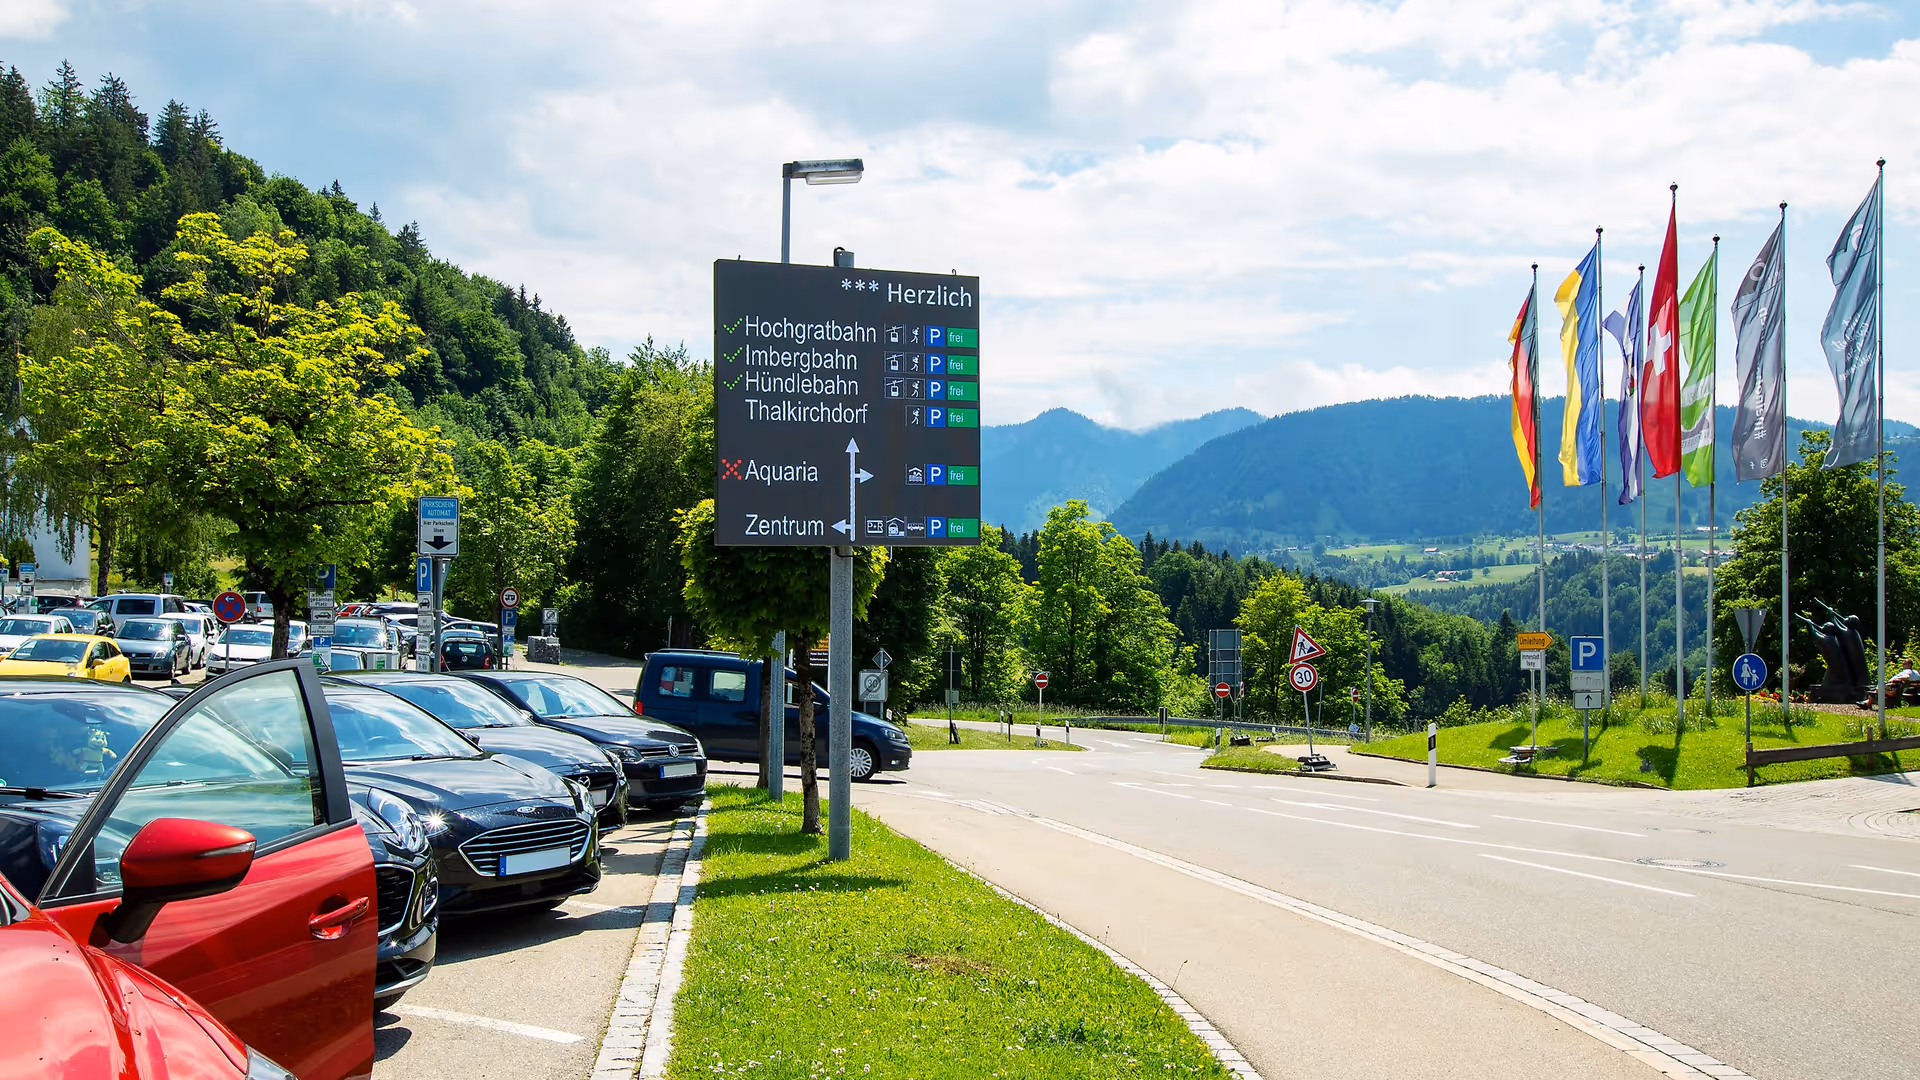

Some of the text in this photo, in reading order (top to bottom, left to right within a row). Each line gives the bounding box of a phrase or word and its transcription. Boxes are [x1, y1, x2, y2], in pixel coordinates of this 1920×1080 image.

[887, 283, 972, 307] Herzlich
[745, 315, 963, 346] Hochgratbahn P frei
[745, 344, 964, 373] Imbergbahn P frei
[745, 372, 964, 397] Hündlebahn P frei
[745, 398, 964, 425] Thalkirchdorf P frei
[744, 459, 964, 486] Aquaria P frei
[745, 514, 824, 536] Zentrum
[931, 520, 942, 535] P
[949, 523, 964, 533] frei
[420, 562, 428, 588] P
[505, 611, 514, 624] P
[1519, 636, 1546, 647] Umleitung
[1579, 641, 1597, 667] P
[867, 679, 879, 688] 30
[1295, 670, 1312, 684] 30
